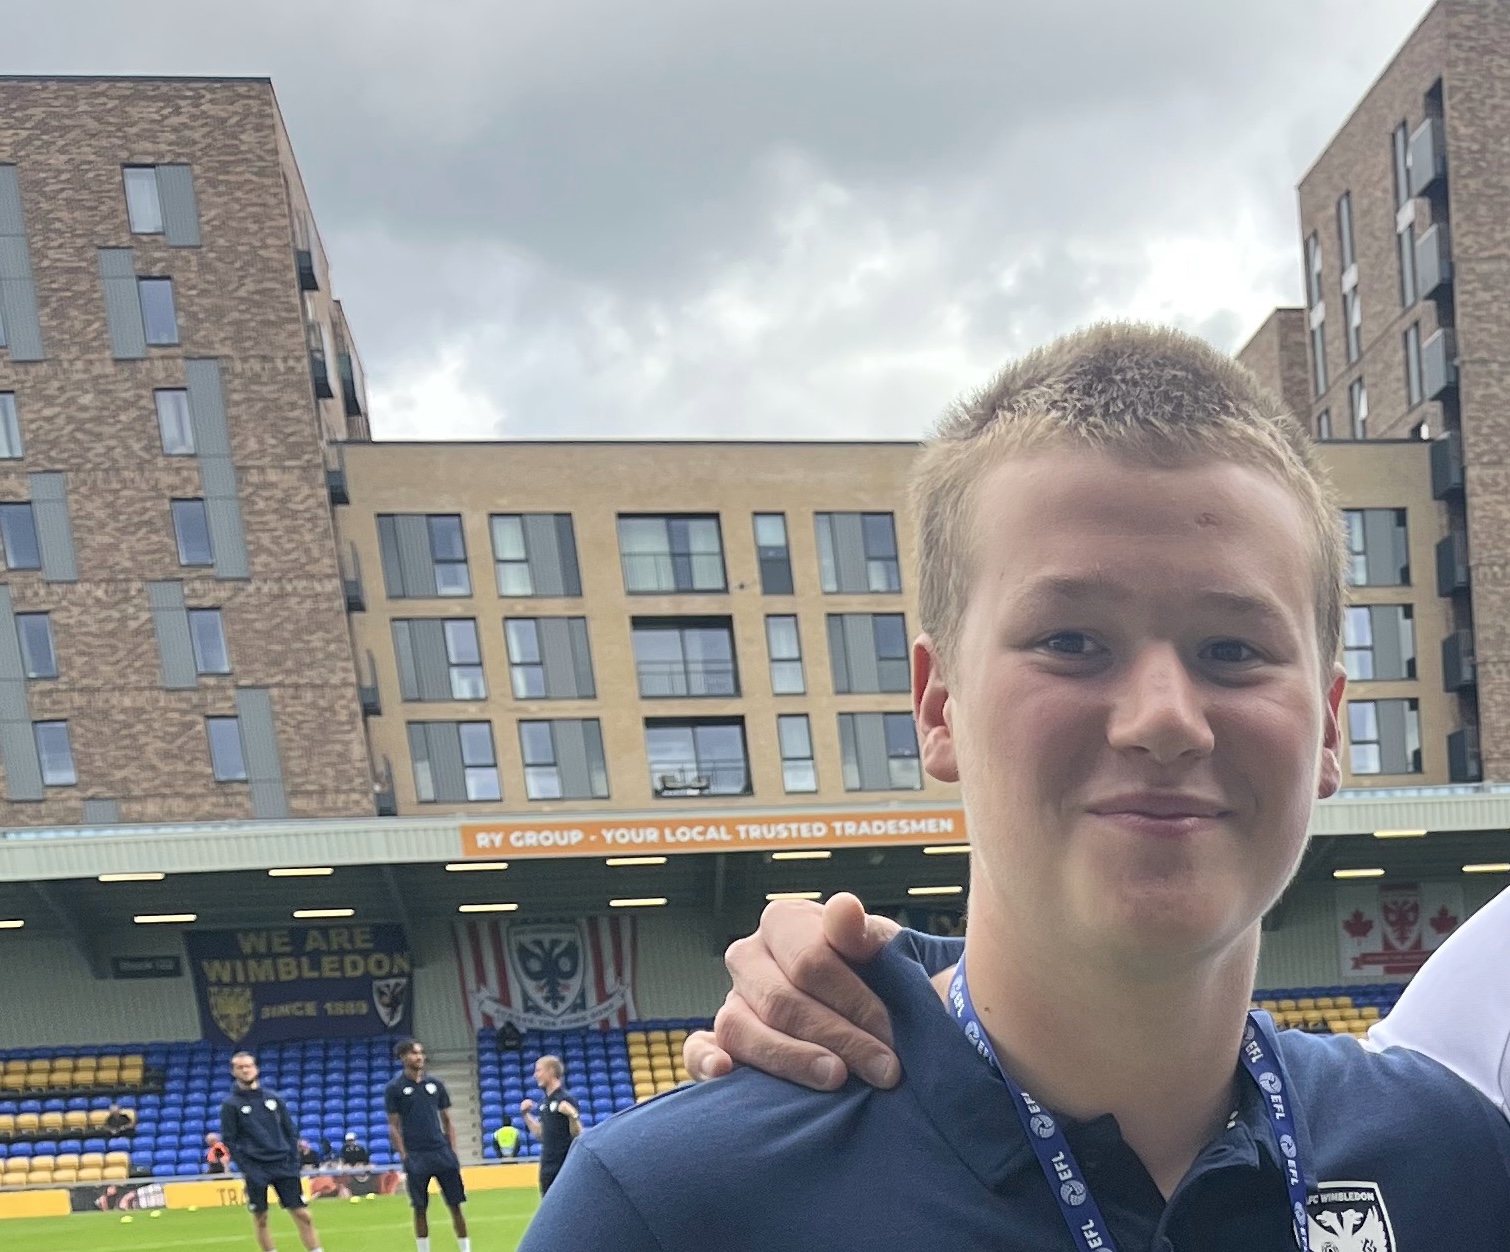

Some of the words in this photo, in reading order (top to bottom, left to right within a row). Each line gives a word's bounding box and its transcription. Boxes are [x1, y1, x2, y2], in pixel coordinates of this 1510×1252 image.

[475, 831, 504, 849] RY
[509, 829, 584, 848] GROUP
[601, 827, 660, 845] YOUR
[664, 825, 732, 843] LOCAL
[736, 821, 828, 840] TRUSTED
[831, 818, 954, 837] TRADESMEN
[237, 930, 294, 955] WE
[305, 926, 374, 952] ARE
[201, 952, 411, 984] WIMBLEDON
[1245, 1041, 1263, 1063] EFL
[1270, 1094, 1286, 1120] EFL
[1052, 1151, 1073, 1181] EFL
[1287, 1159, 1299, 1186] EFL
[1307, 1194, 1319, 1205] FC
[1320, 1191, 1375, 1203] WIMBLEDON
[1081, 1219, 1103, 1249] EFL
